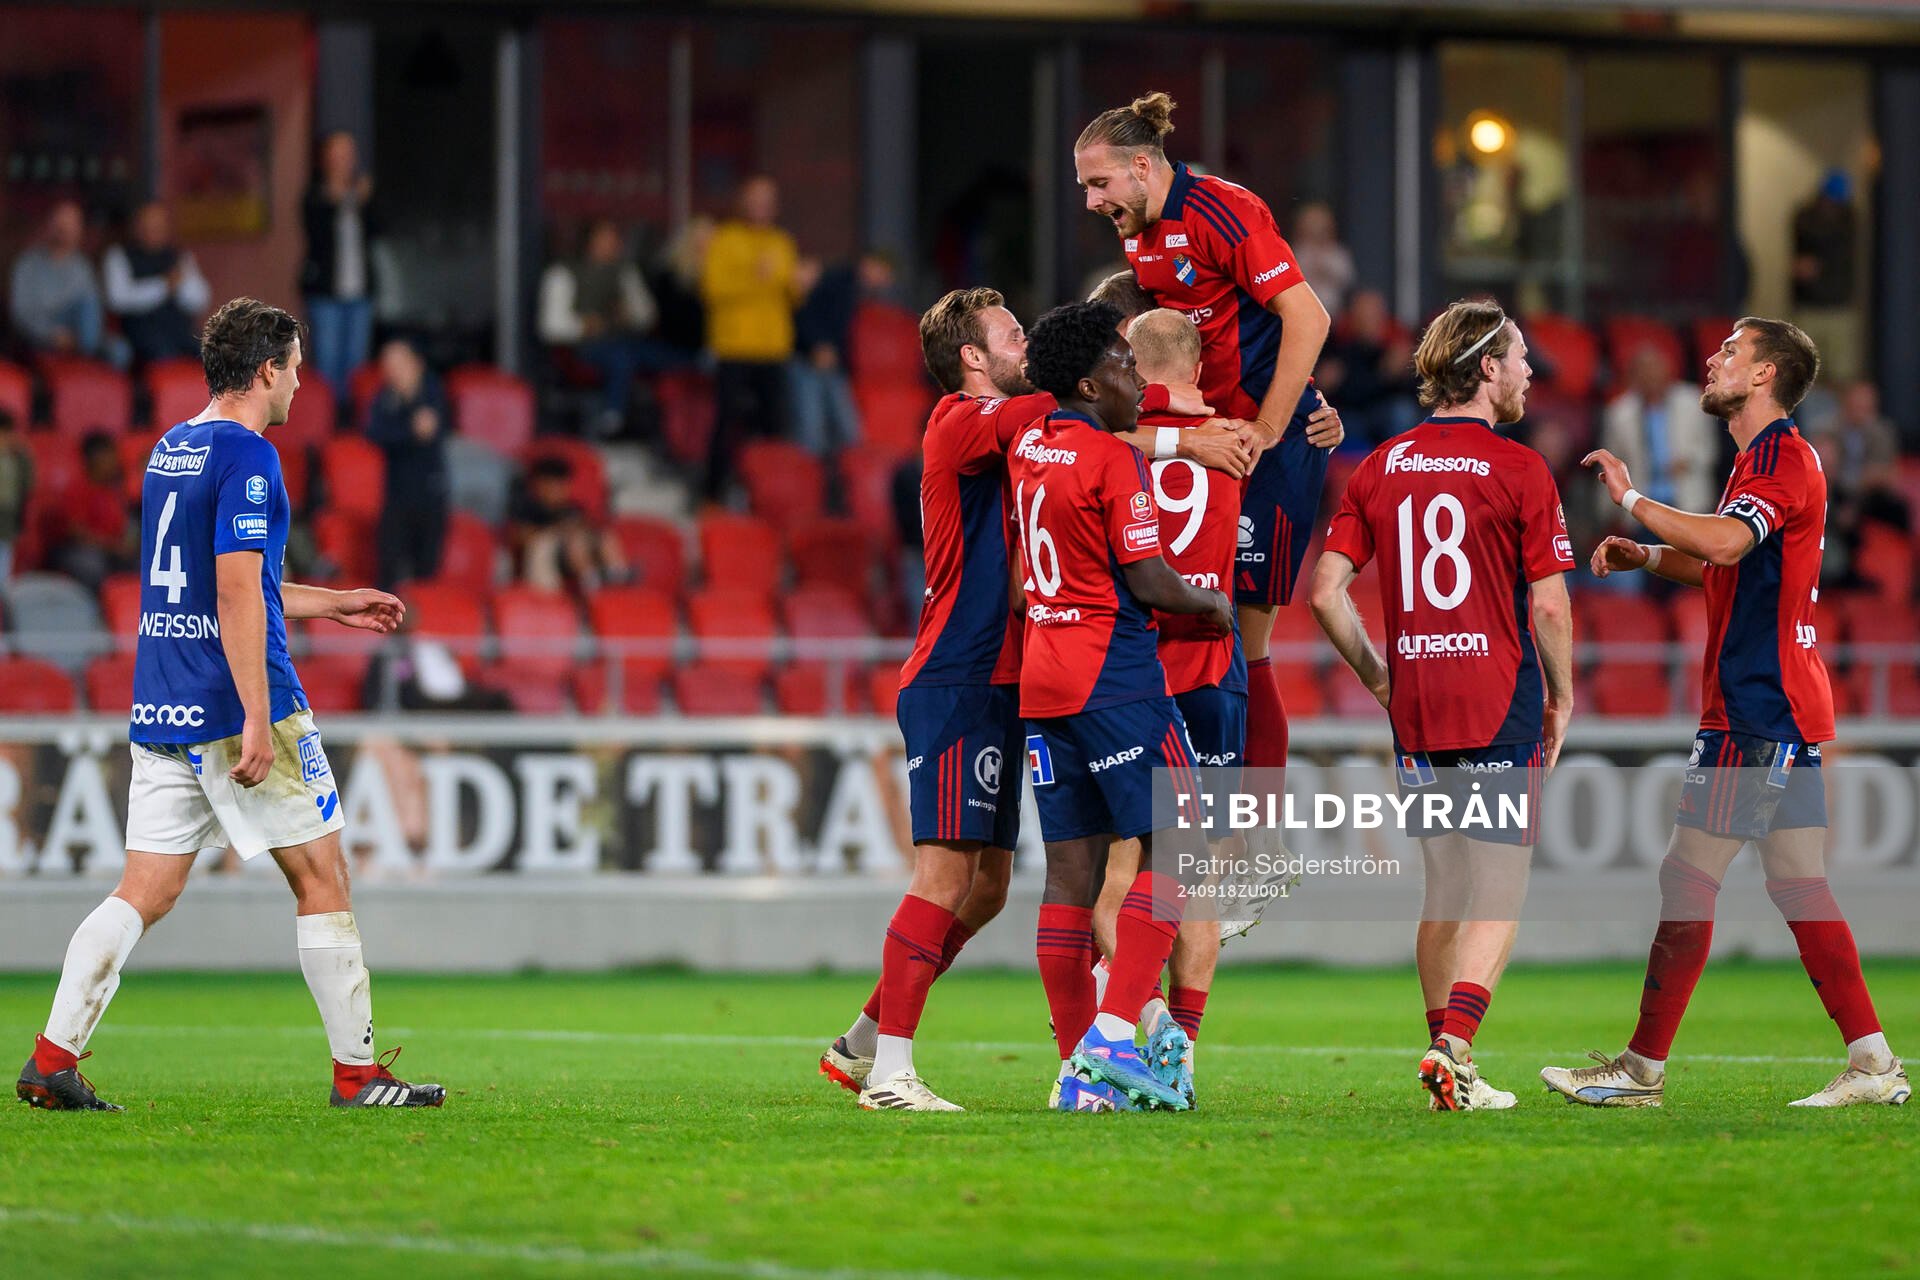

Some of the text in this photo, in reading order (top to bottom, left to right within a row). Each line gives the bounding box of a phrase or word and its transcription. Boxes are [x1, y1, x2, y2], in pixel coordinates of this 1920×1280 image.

[1259, 261, 1290, 282] bravida
[1385, 440, 1490, 476] Fellessons
[1150, 458, 1209, 556] 9
[150, 491, 187, 604] 4
[1016, 480, 1062, 597] 16
[1398, 493, 1471, 612] 18
[1397, 629, 1488, 660] dynacon
[1088, 746, 1144, 773] SHARP
[1457, 756, 1514, 775] SHARP
